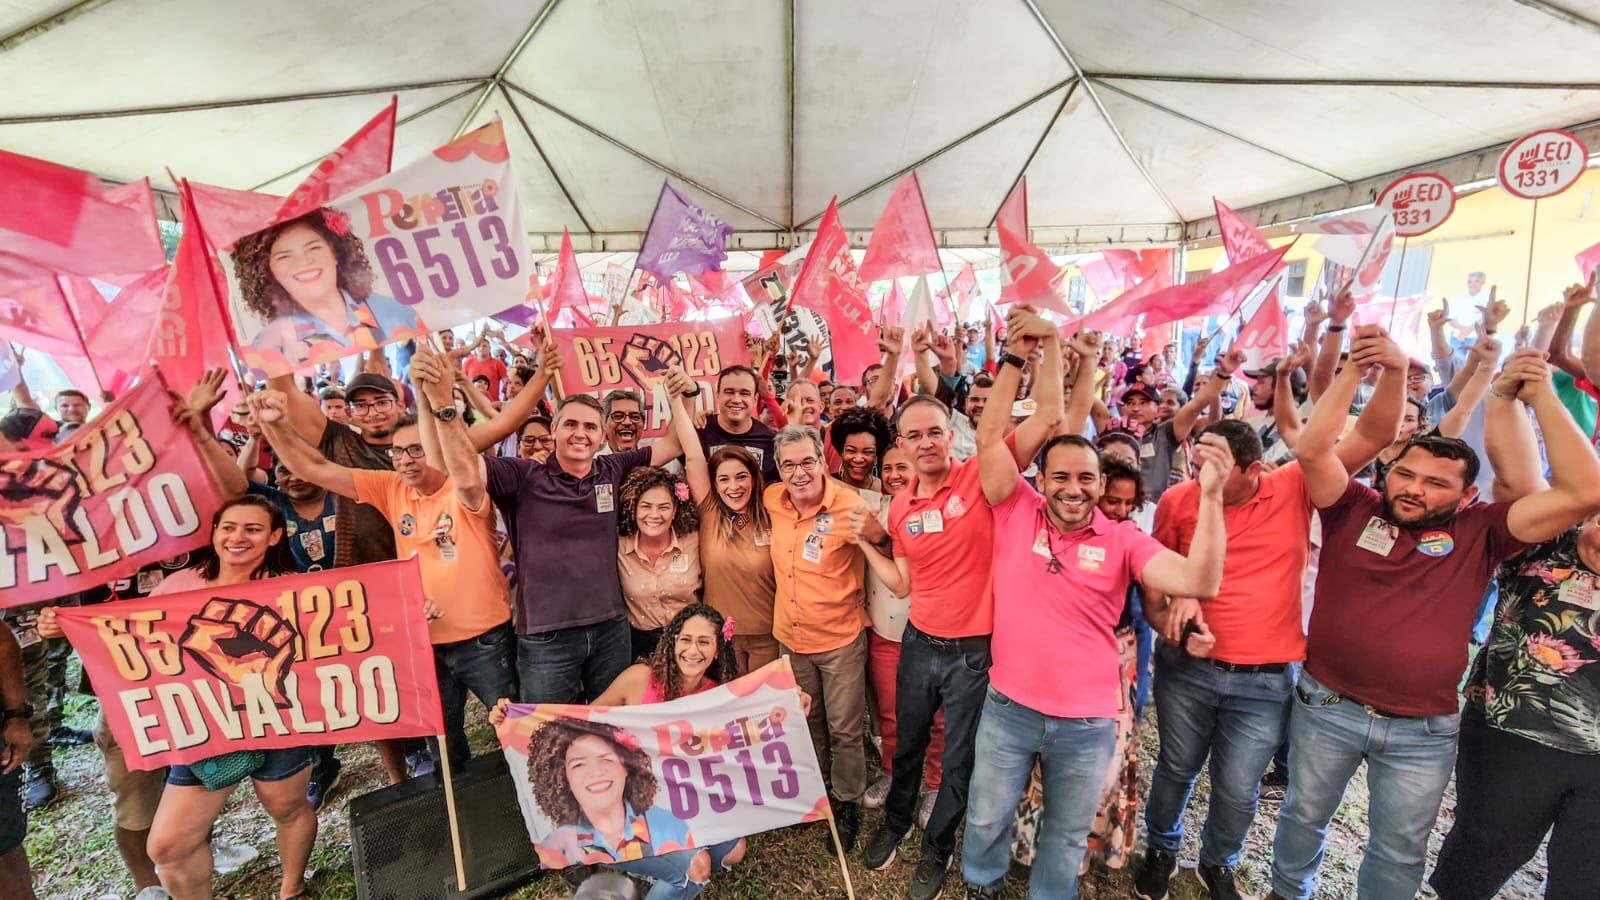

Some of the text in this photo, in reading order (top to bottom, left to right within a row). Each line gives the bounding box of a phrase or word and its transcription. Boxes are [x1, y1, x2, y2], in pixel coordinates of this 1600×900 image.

[1392, 209, 1431, 226] 1331
[1514, 168, 1559, 188] 1331
[374, 215, 520, 306] 6513
[834, 294, 872, 335] LULA
[572, 331, 721, 387] 65 123
[57, 409, 156, 498] 123
[90, 580, 373, 681] 65 123
[118, 655, 401, 757] EDVALDO
[661, 741, 800, 820] 6513
